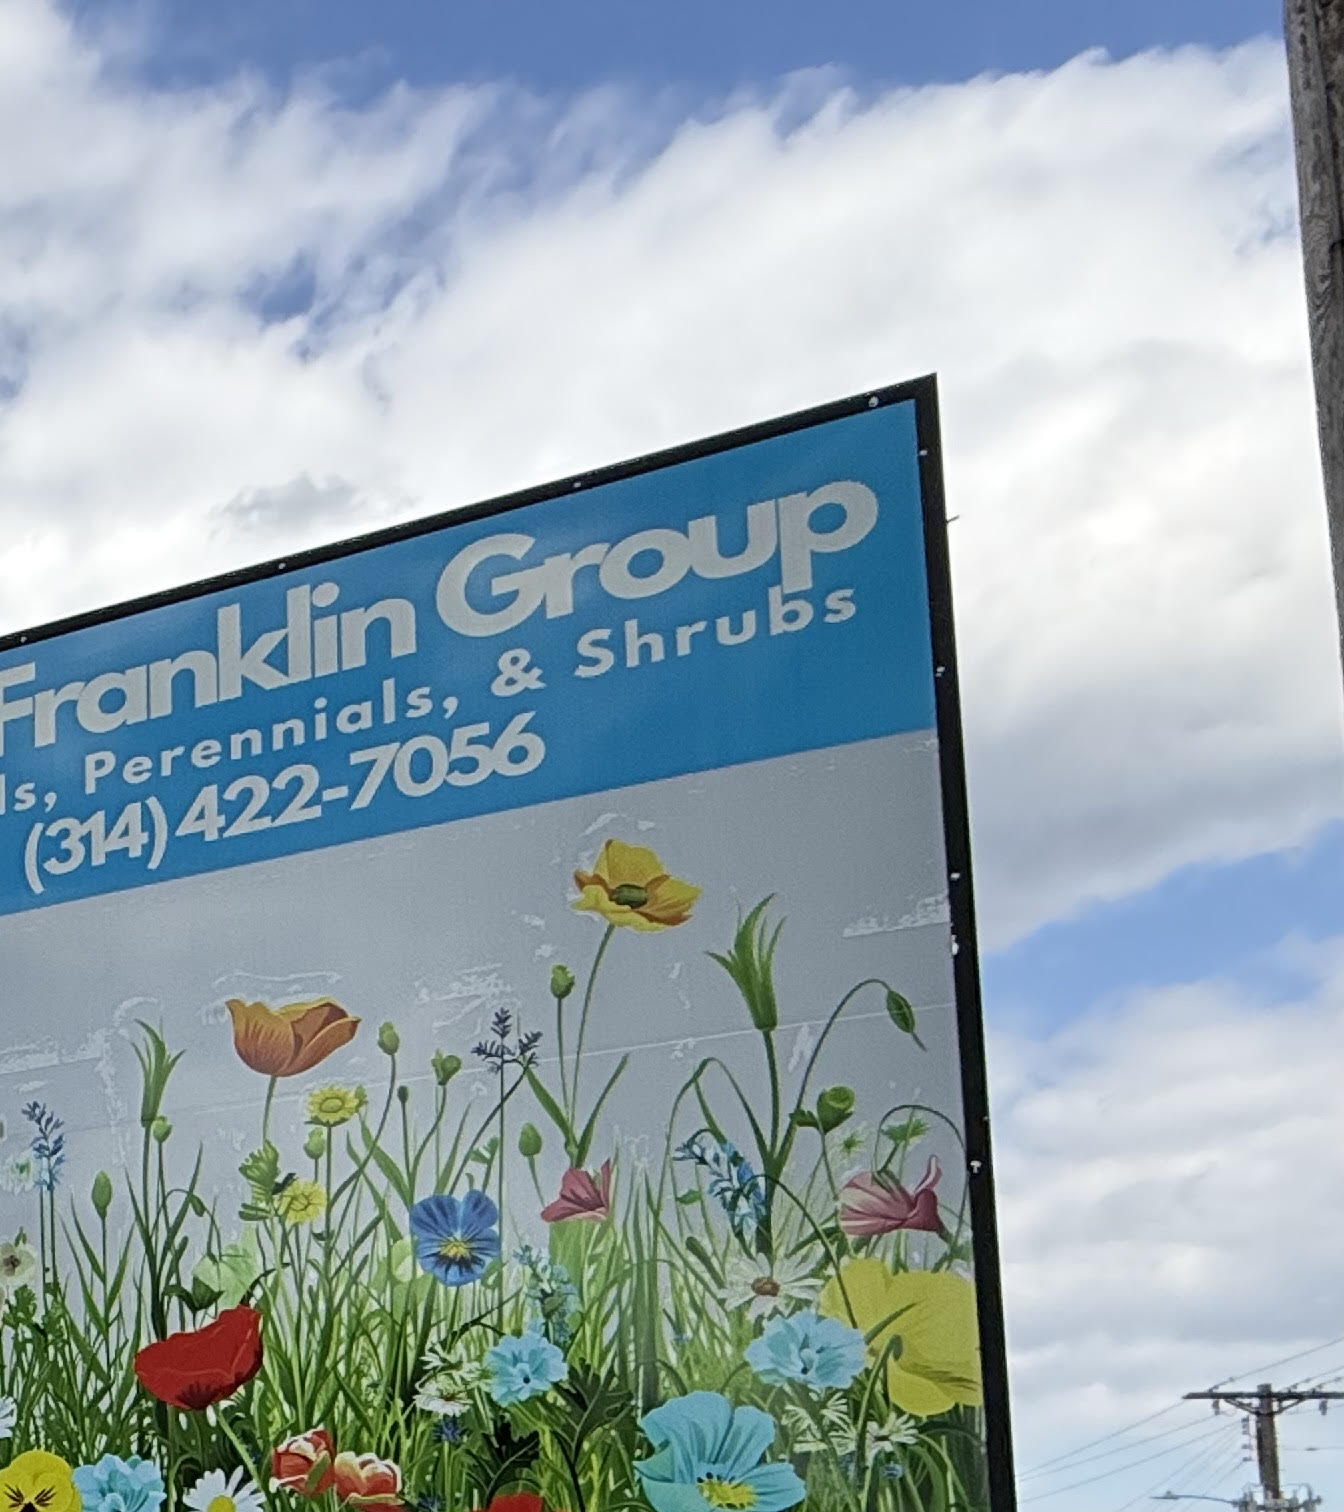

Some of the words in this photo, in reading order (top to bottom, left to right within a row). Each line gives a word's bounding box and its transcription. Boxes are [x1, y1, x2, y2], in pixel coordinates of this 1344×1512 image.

[436, 480, 879, 636] Group
[84, 680, 461, 795] Perennials,
[491, 648, 542, 695] &
[574, 586, 859, 679] Shrubs
